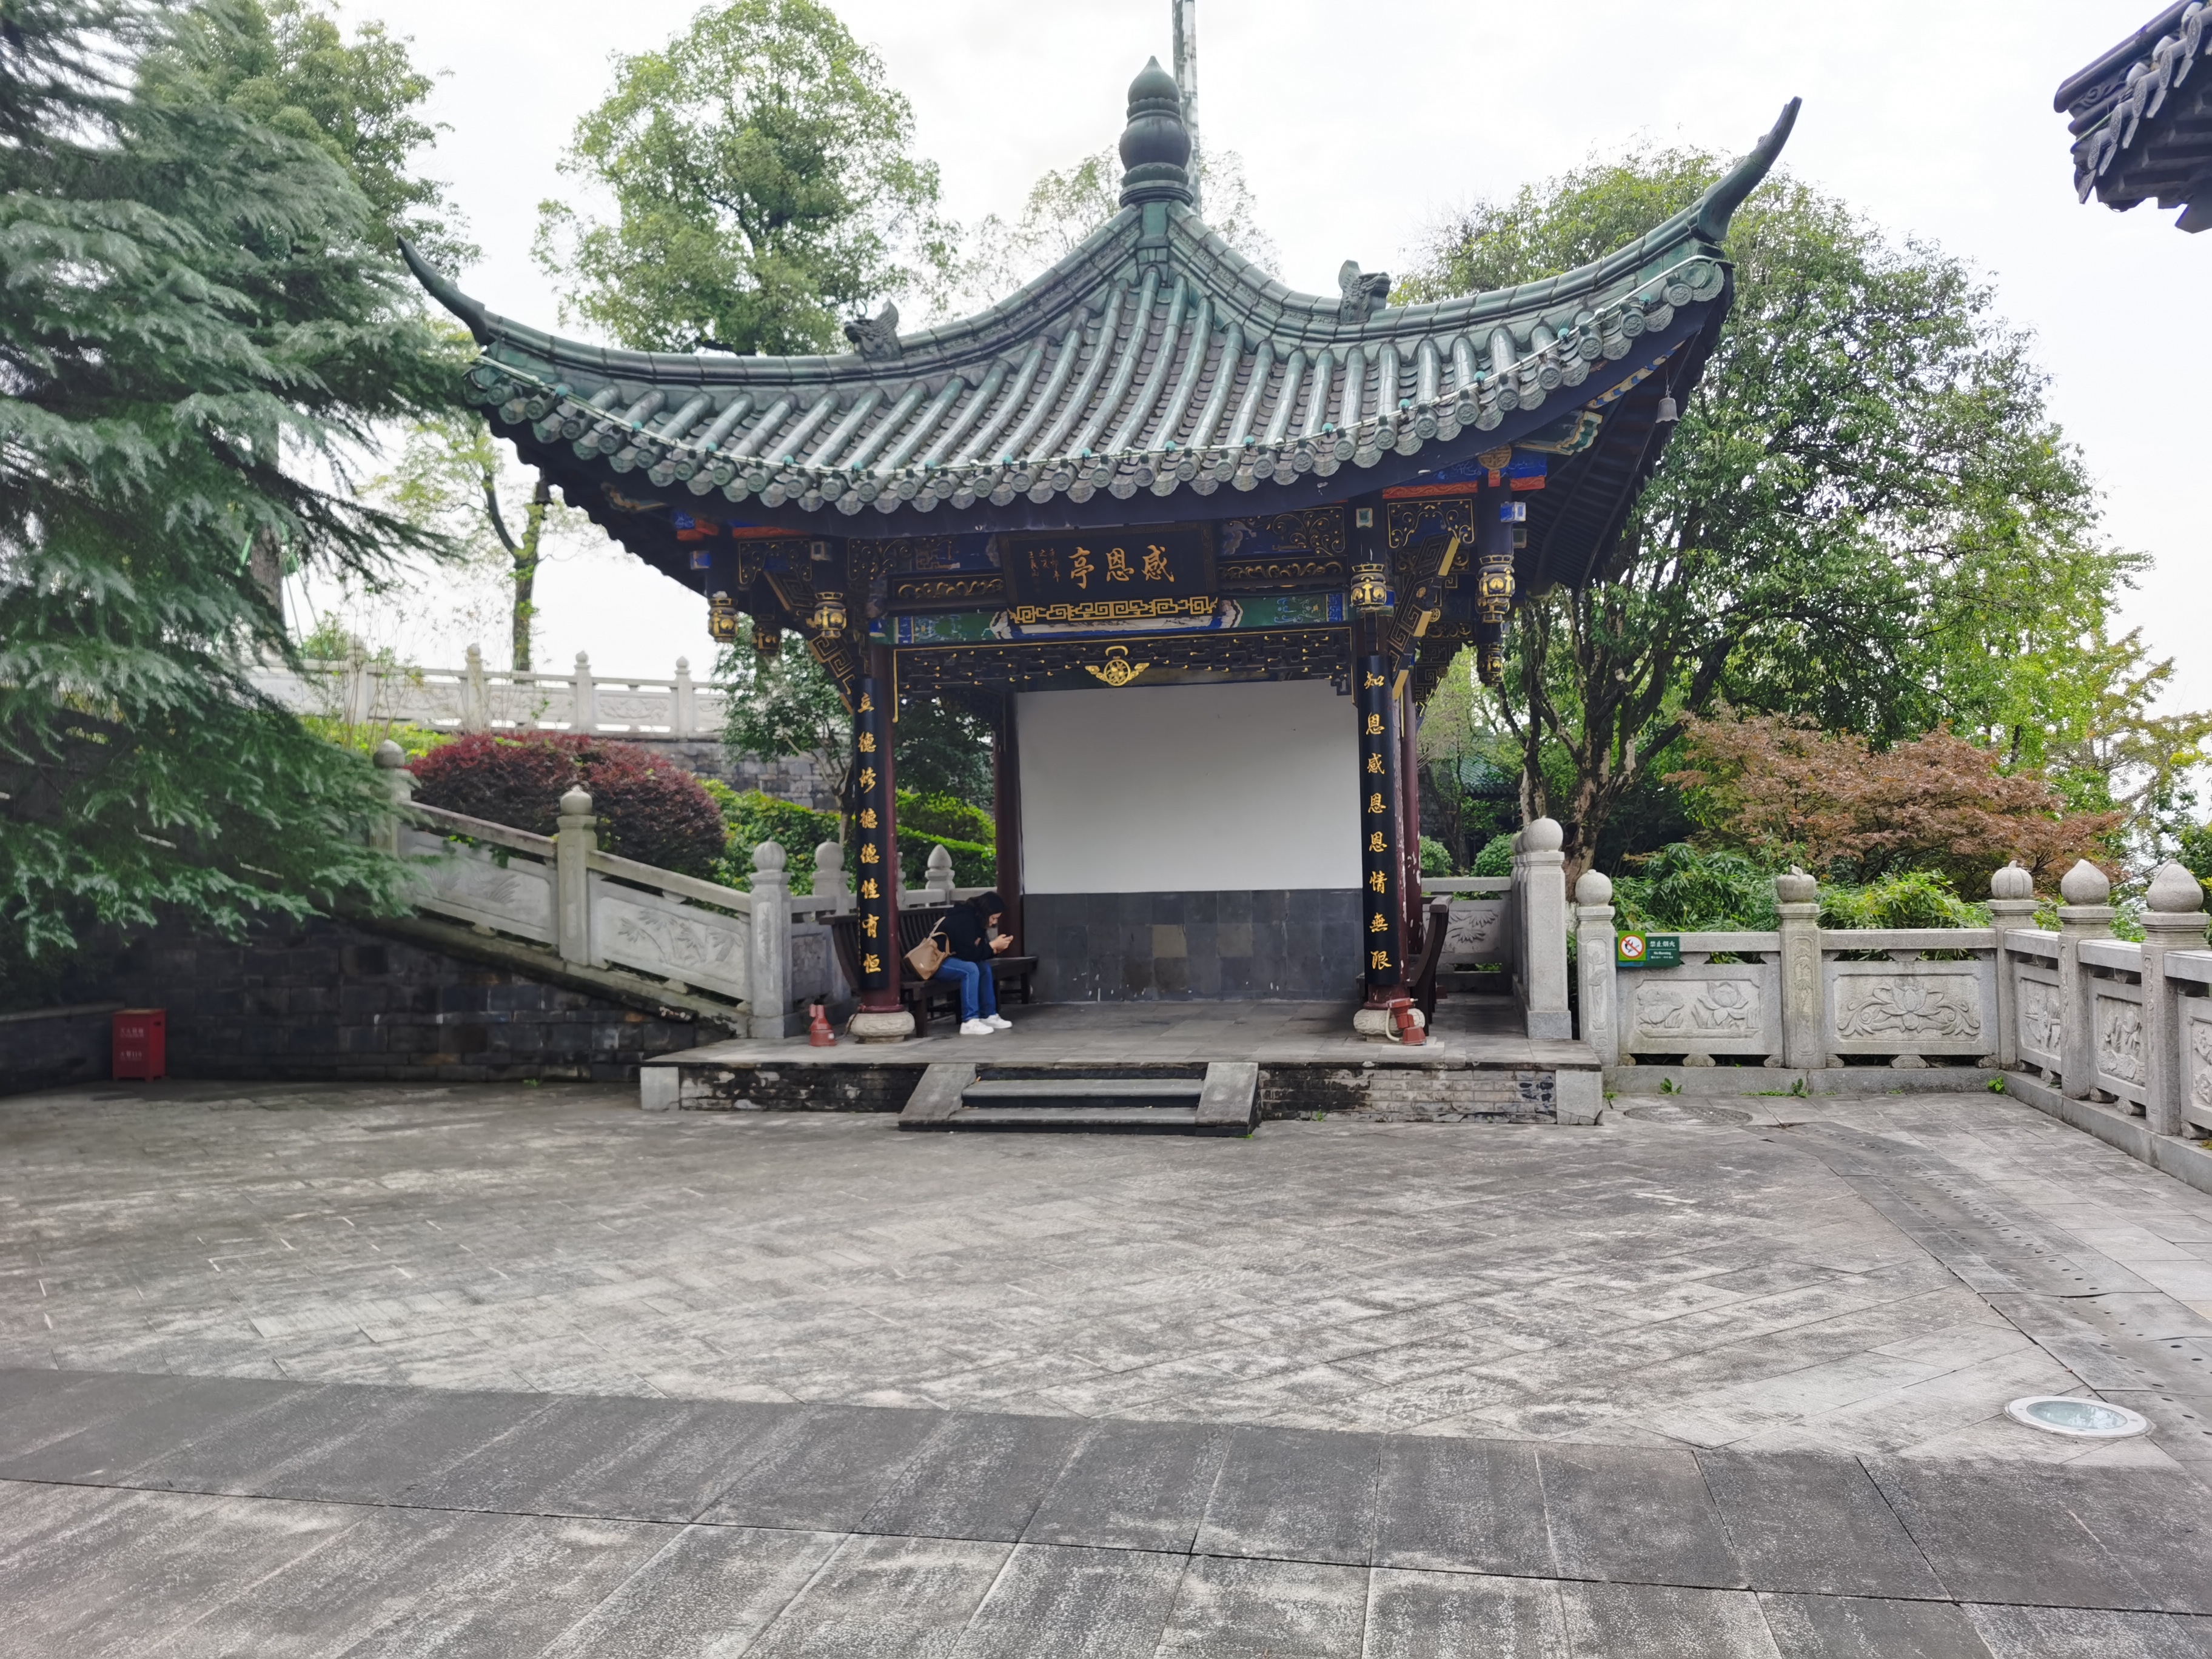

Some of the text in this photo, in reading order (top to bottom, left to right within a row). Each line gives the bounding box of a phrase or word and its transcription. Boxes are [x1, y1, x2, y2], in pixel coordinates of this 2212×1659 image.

[1068, 545, 1175, 589] 感恩亭
[1364, 671, 1393, 971] 知恩感恩恩情無限
